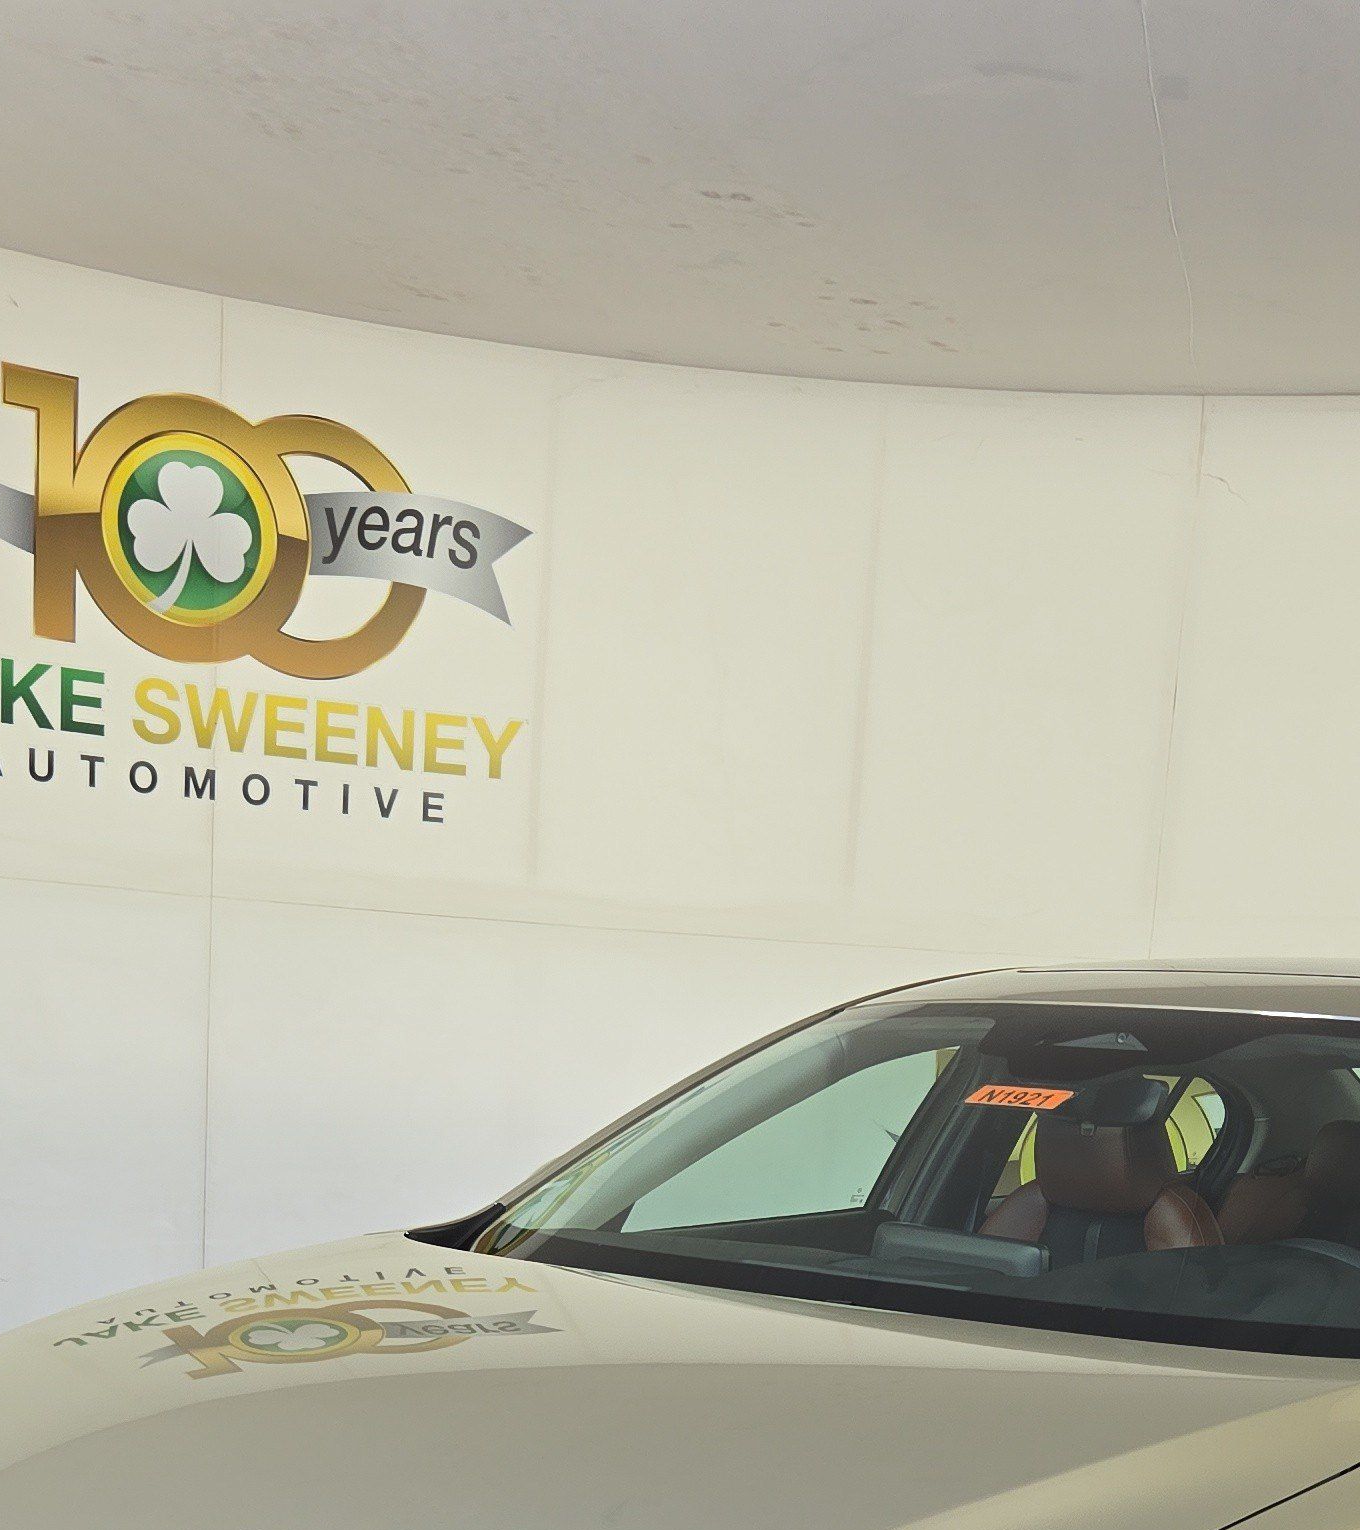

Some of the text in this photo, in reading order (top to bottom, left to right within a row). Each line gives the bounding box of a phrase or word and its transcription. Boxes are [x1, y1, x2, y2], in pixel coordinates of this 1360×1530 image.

[1, 361, 482, 680] 100 years
[131, 677, 525, 780] SWEENEY
[978, 1089, 1055, 1107] N1921
